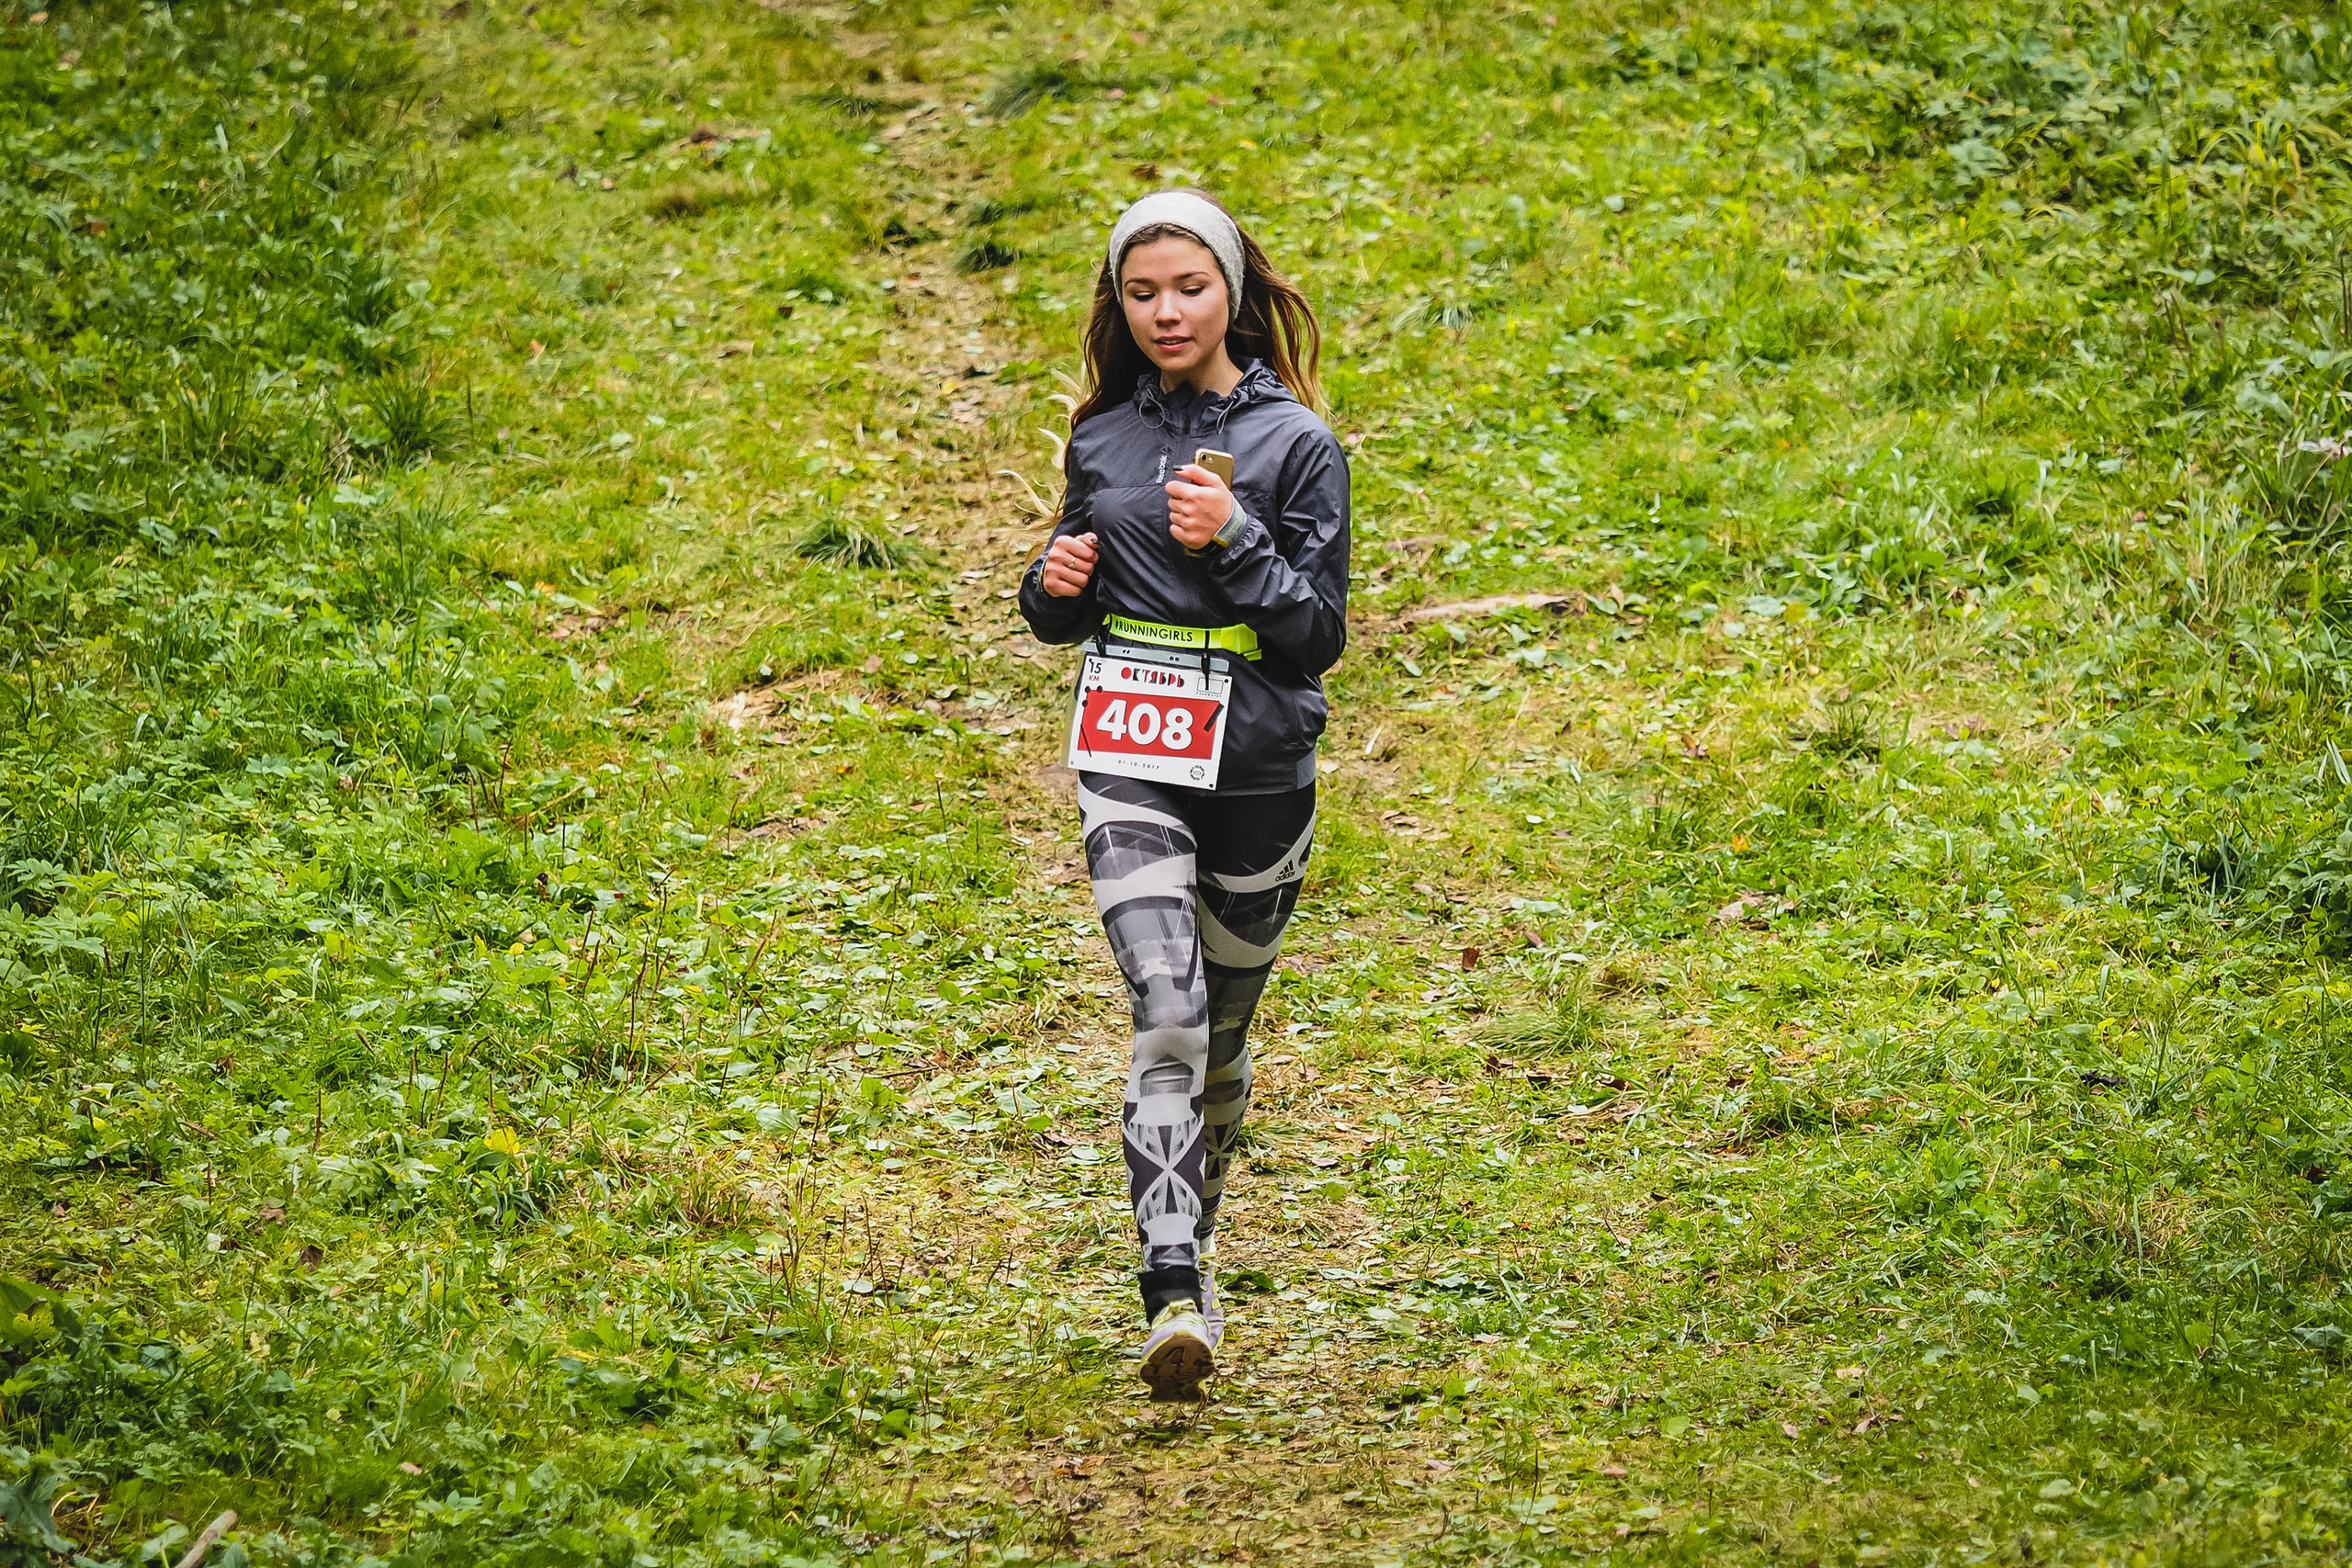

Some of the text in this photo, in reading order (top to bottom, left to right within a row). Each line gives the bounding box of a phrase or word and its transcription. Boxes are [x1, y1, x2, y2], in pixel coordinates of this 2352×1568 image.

[1156, 455, 1168, 484] Reebok
[1114, 618, 1193, 642] #RUNNINGIRLS
[1089, 660, 1102, 674] 15
[1121, 666, 1185, 688] ОКТЯБРЬ
[1096, 699, 1193, 750] 408
[1117, 760, 1160, 770] 01.10.2017
[1275, 870, 1295, 882] adidas
